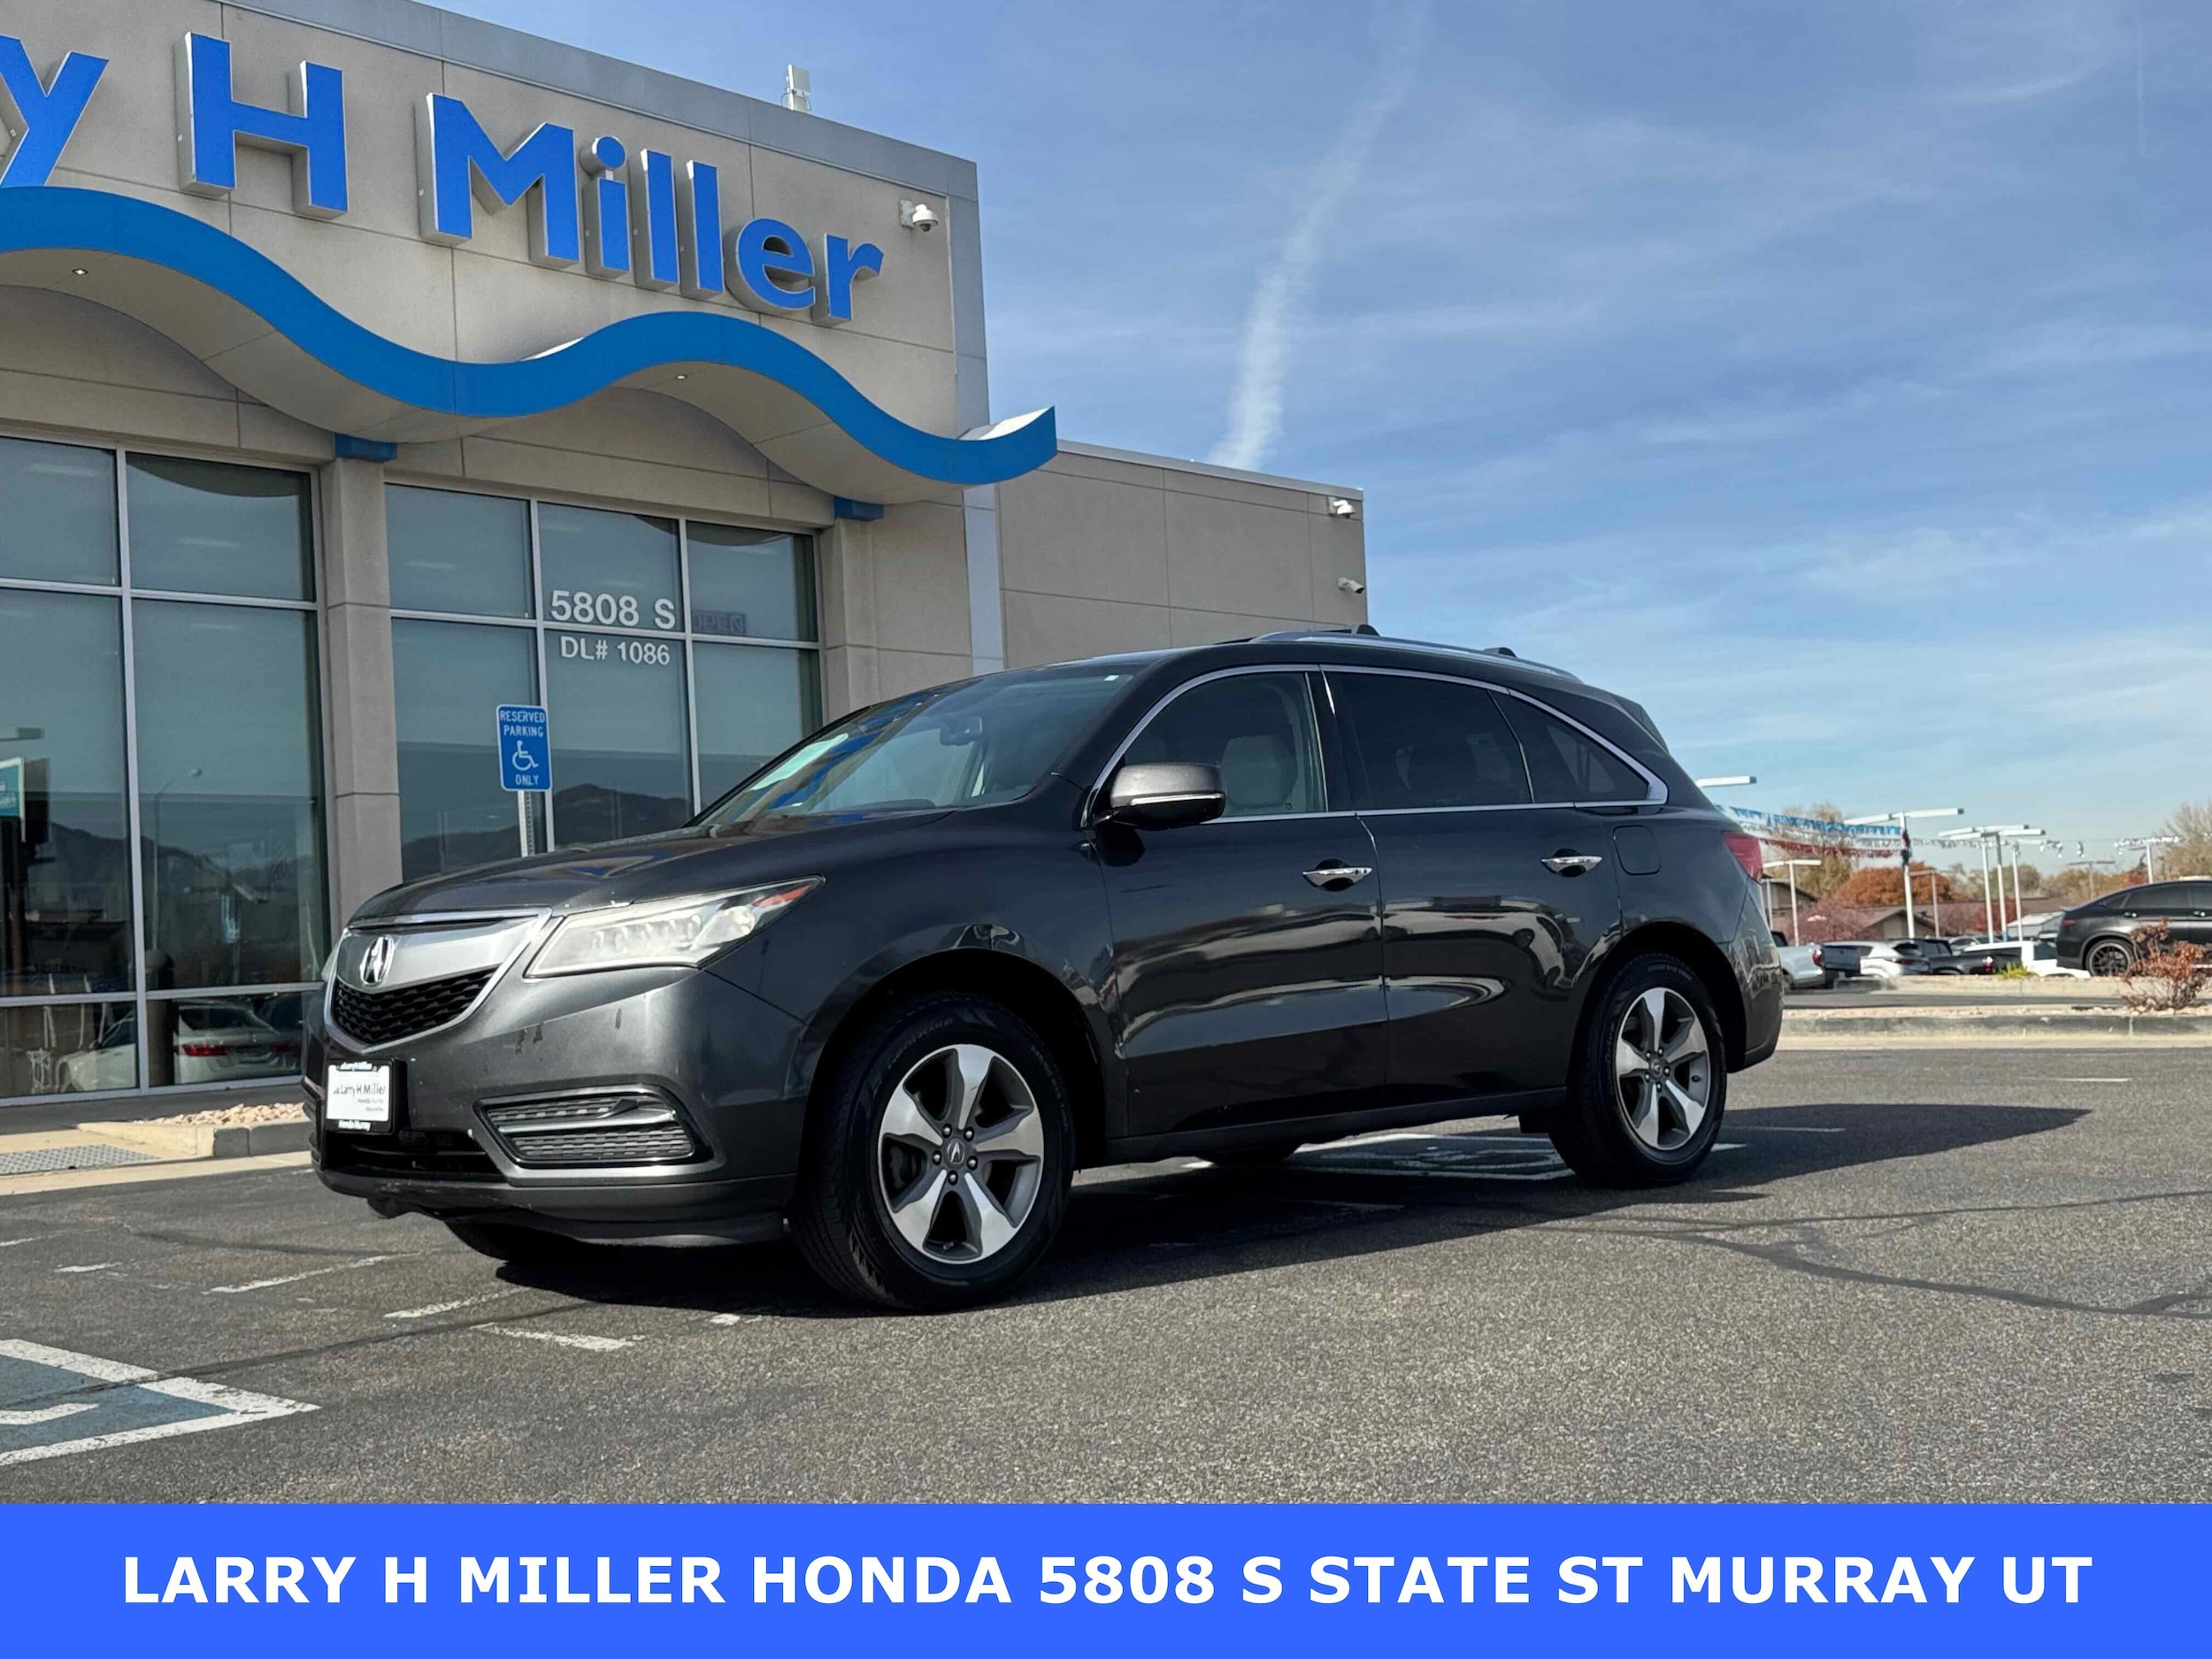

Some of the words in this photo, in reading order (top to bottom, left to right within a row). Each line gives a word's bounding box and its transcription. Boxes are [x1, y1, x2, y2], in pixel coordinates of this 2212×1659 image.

[186, 31, 349, 212] H
[426, 92, 884, 323] Miller
[551, 590, 639, 626] 5808
[655, 598, 676, 629] S
[560, 635, 609, 660] DL#
[617, 641, 671, 665] 1086
[499, 710, 546, 723] RESERVED
[503, 725, 544, 738] PARKING
[515, 774, 540, 786] ONLY
[357, 1084, 362, 1094] H
[363, 1082, 387, 1094] Miller
